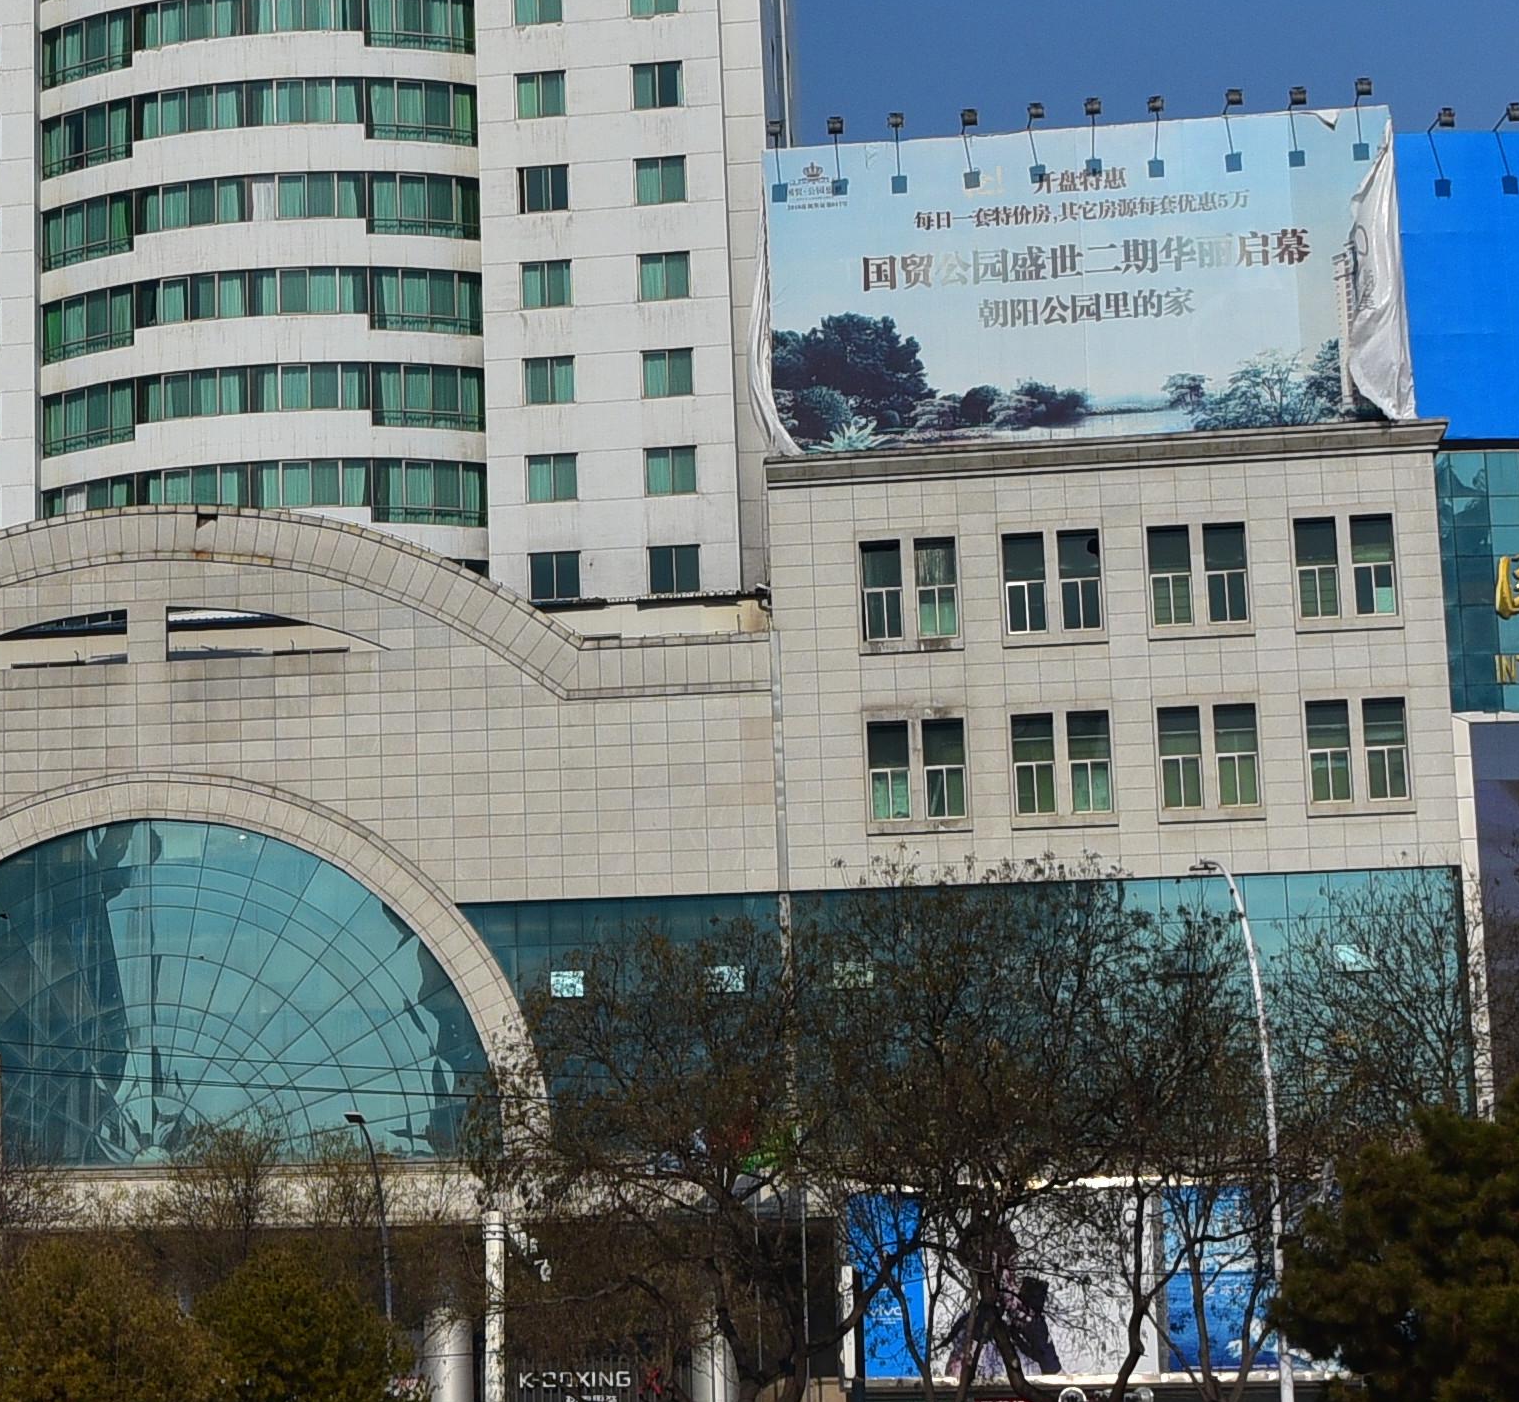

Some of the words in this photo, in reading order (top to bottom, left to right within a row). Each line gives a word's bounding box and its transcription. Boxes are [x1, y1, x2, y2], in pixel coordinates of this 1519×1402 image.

[1033, 167, 1128, 195] 开盘特惠
[861, 228, 1312, 292] 国贸公园盛世二期华丽启幕
[978, 286, 1196, 329] 朝阳公园里的家
